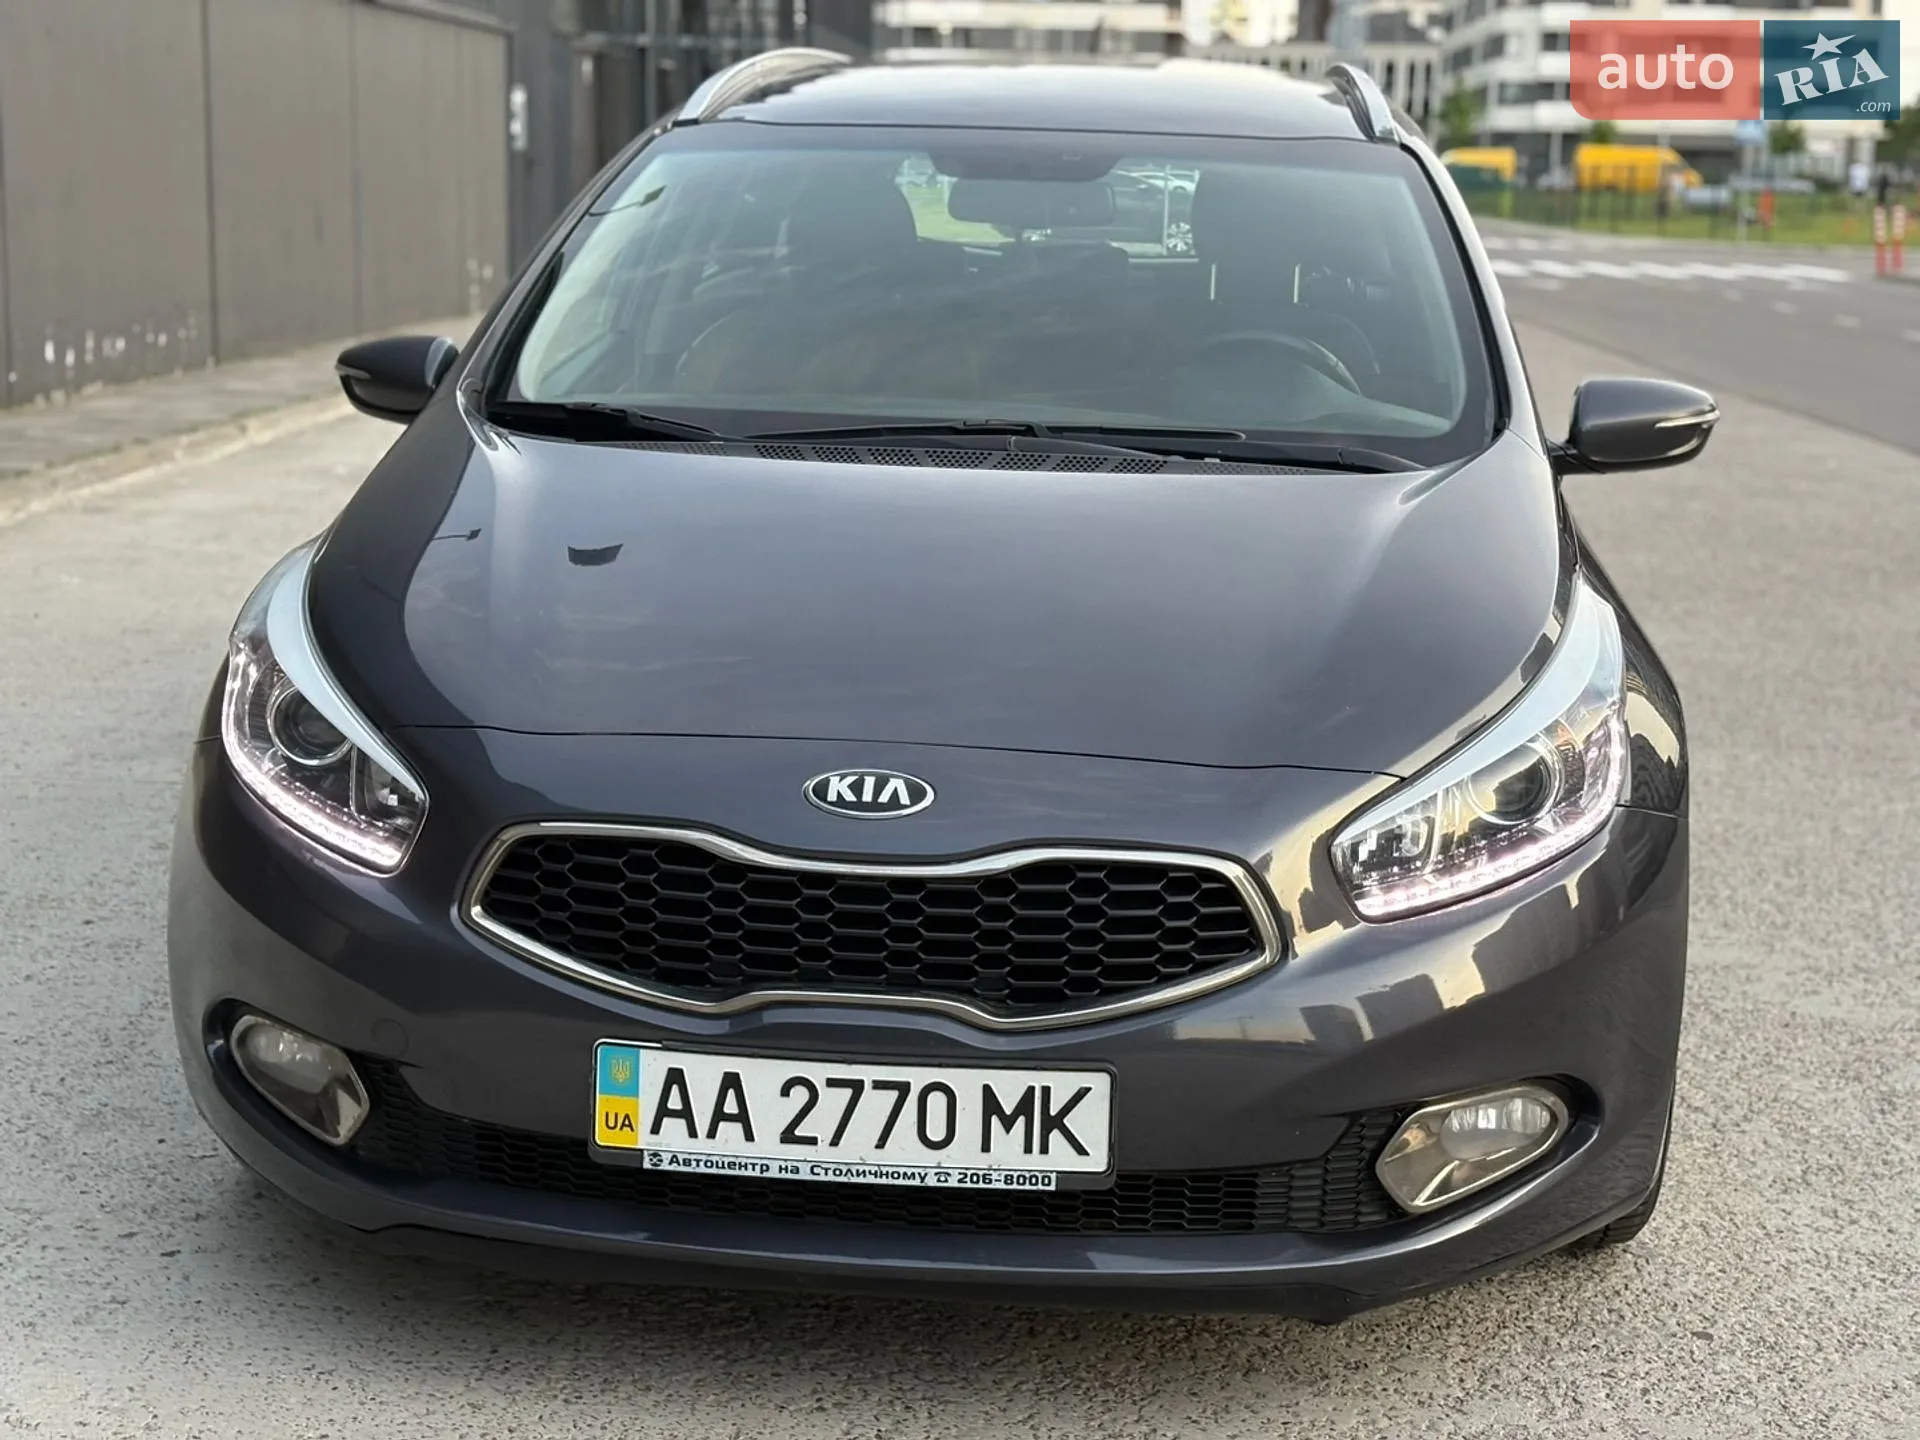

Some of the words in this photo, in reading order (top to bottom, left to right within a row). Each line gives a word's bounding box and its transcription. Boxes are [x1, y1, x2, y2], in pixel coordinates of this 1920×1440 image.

[826, 775, 911, 806] KIA
[605, 1111, 635, 1133] UA
[649, 1066, 754, 1143] AA
[779, 1076, 958, 1151] 2770
[981, 1083, 1092, 1157] MK
[668, 1154, 770, 1175] Автоцентр
[778, 1163, 801, 1175] на
[809, 1164, 928, 1184] Столичному
[957, 1171, 1051, 1188] 206-8000
